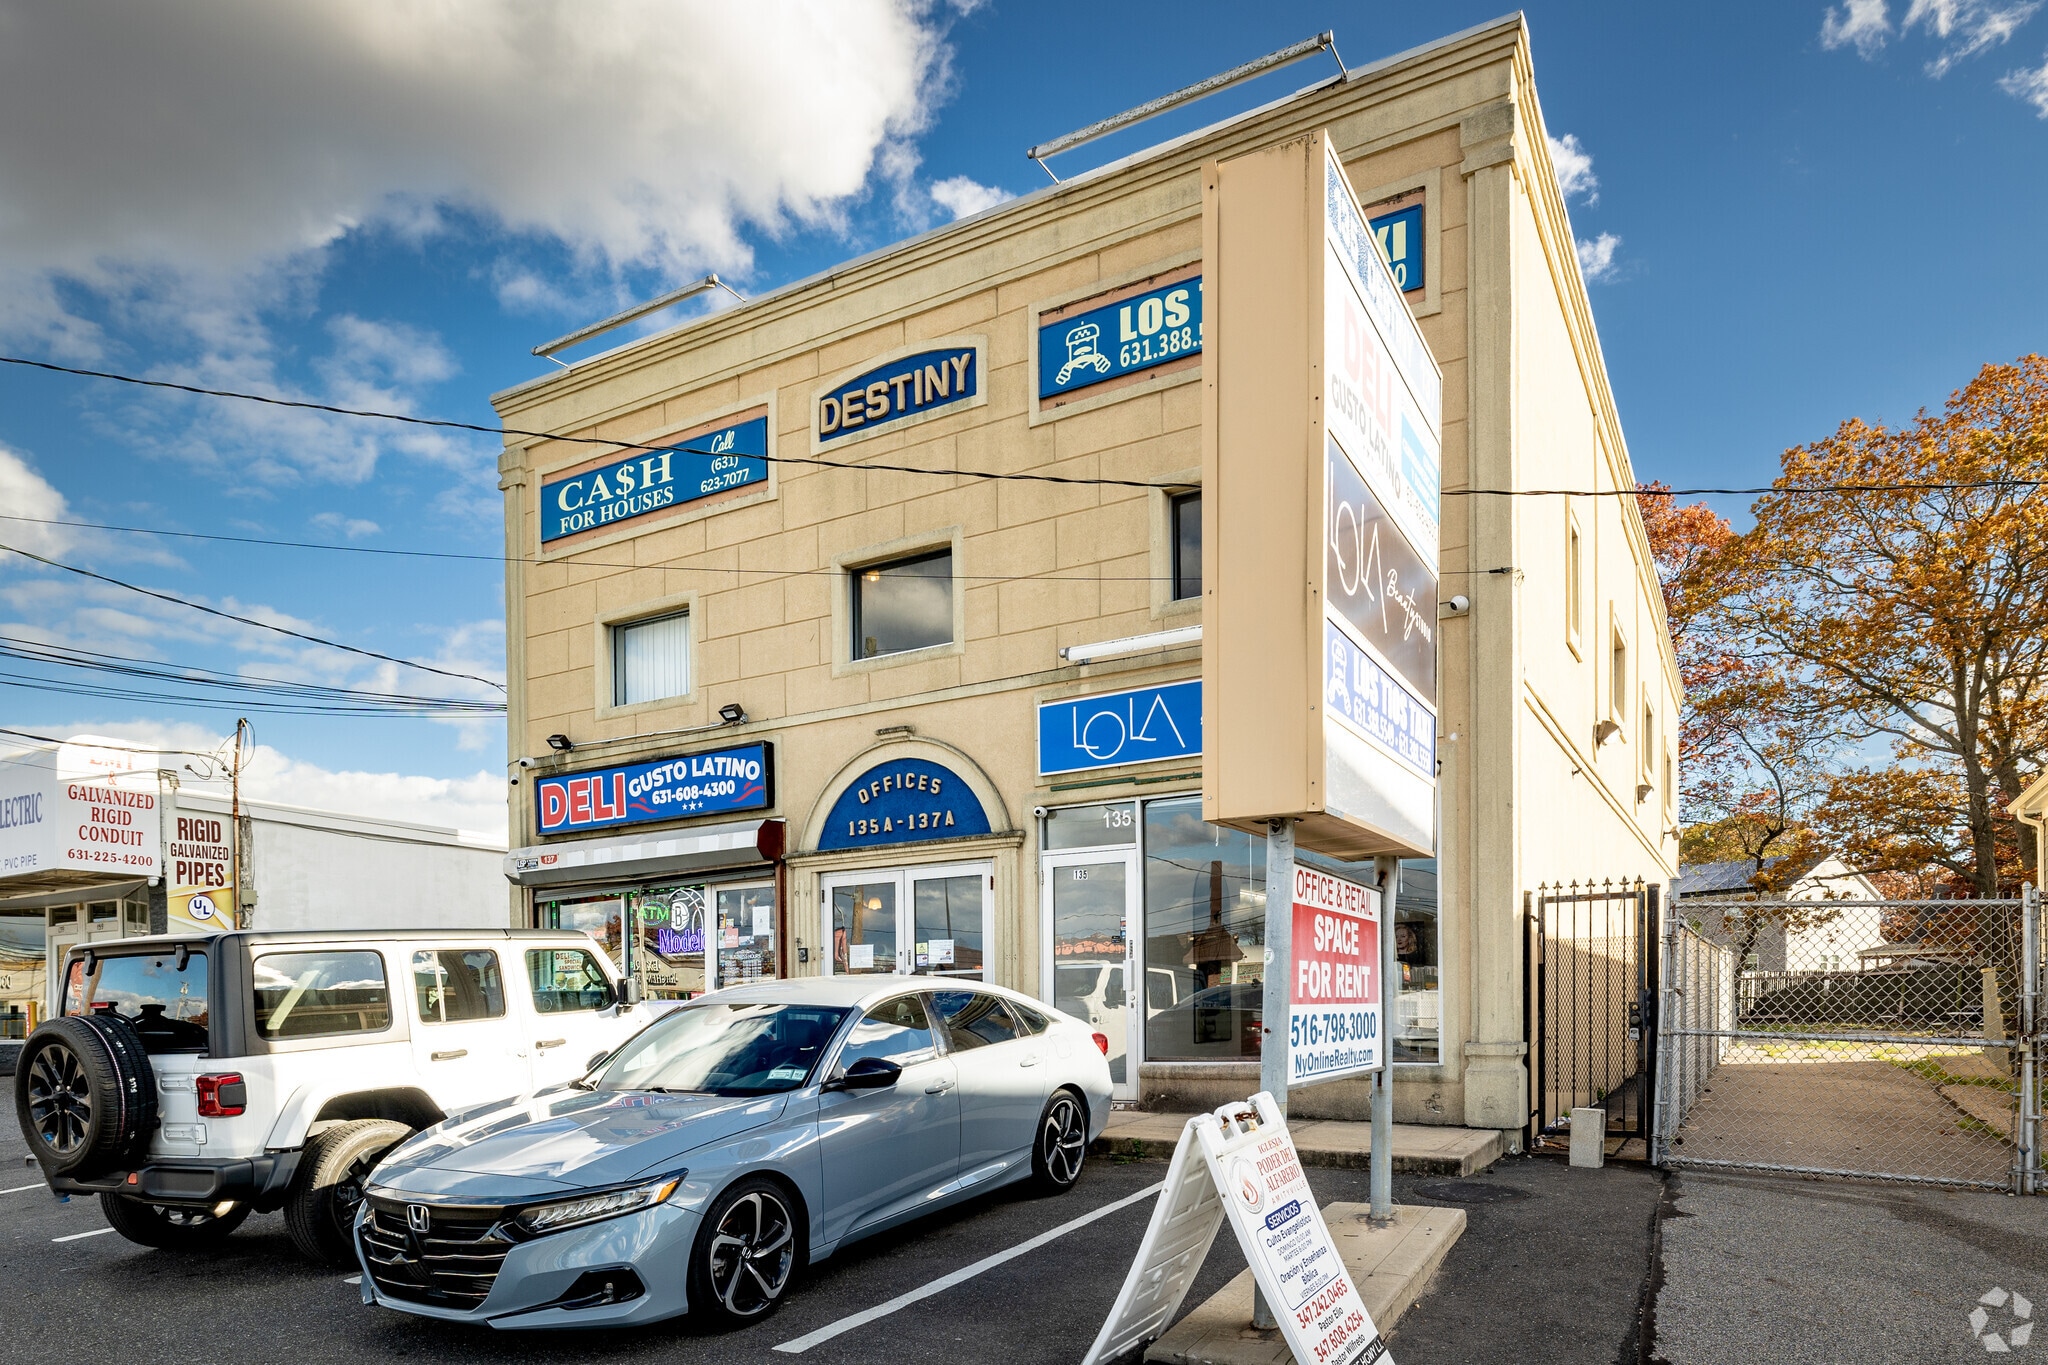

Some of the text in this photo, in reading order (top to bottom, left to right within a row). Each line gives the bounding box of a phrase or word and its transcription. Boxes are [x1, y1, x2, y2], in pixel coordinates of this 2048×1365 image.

[1120, 290, 1190, 342] LOS
[1119, 326, 1202, 367] 631.388.
[1344, 295, 1391, 440] DELI
[820, 352, 972, 435] DESTINY
[711, 430, 735, 453] Call
[1332, 374, 1401, 500] GUSTO LATINO
[711, 456, 738, 474] (631)
[557, 452, 674, 512] CA$H
[701, 468, 749, 492] 623-7077
[559, 486, 674, 535] FOR HOUSES
[1331, 461, 1387, 634] LOLA
[1353, 650, 1432, 750] LOS TIOS TAXI
[1072, 694, 1185, 760] LOLA
[629, 756, 760, 797] GUSTO LATINO
[858, 772, 942, 804] OFFICES
[68, 784, 154, 810] GALVANIZED
[541, 772, 627, 828] DELI
[652, 780, 735, 805] 631-608-4300
[91, 807, 132, 825] RIGID
[177, 817, 221, 843] RIGID
[1103, 810, 1132, 828] 135
[79, 825, 144, 846] CONDUIT
[5, 857, 19, 869] PVC
[21, 854, 37, 867] PIPE
[67, 849, 153, 866] 631-225-4200
[170, 843, 229, 860] GALVANIZED
[176, 860, 225, 887] PIPES
[1074, 870, 1087, 880] 135
[1296, 869, 1373, 916] OFFICE & RETAIL
[637, 906, 669, 920] ATM
[1314, 913, 1360, 956] SPACE
[1298, 960, 1371, 998] FOR RENT
[1291, 1011, 1377, 1048] 516-798-3000
[1295, 1047, 1374, 1076] NyOnlineRealty.com
[1257, 1136, 1283, 1154] IGLESIA
[1256, 1146, 1295, 1176] PODER DEL
[1265, 1163, 1301, 1192] ALFARERO
[1267, 1202, 1300, 1228] SERVICIOS
[1266, 1232, 1282, 1248] Culto
[1296, 1278, 1348, 1330] 347.242.0465
[1314, 1309, 1364, 1363] 347.608.4254
[1318, 1315, 1335, 1332] Pastor
